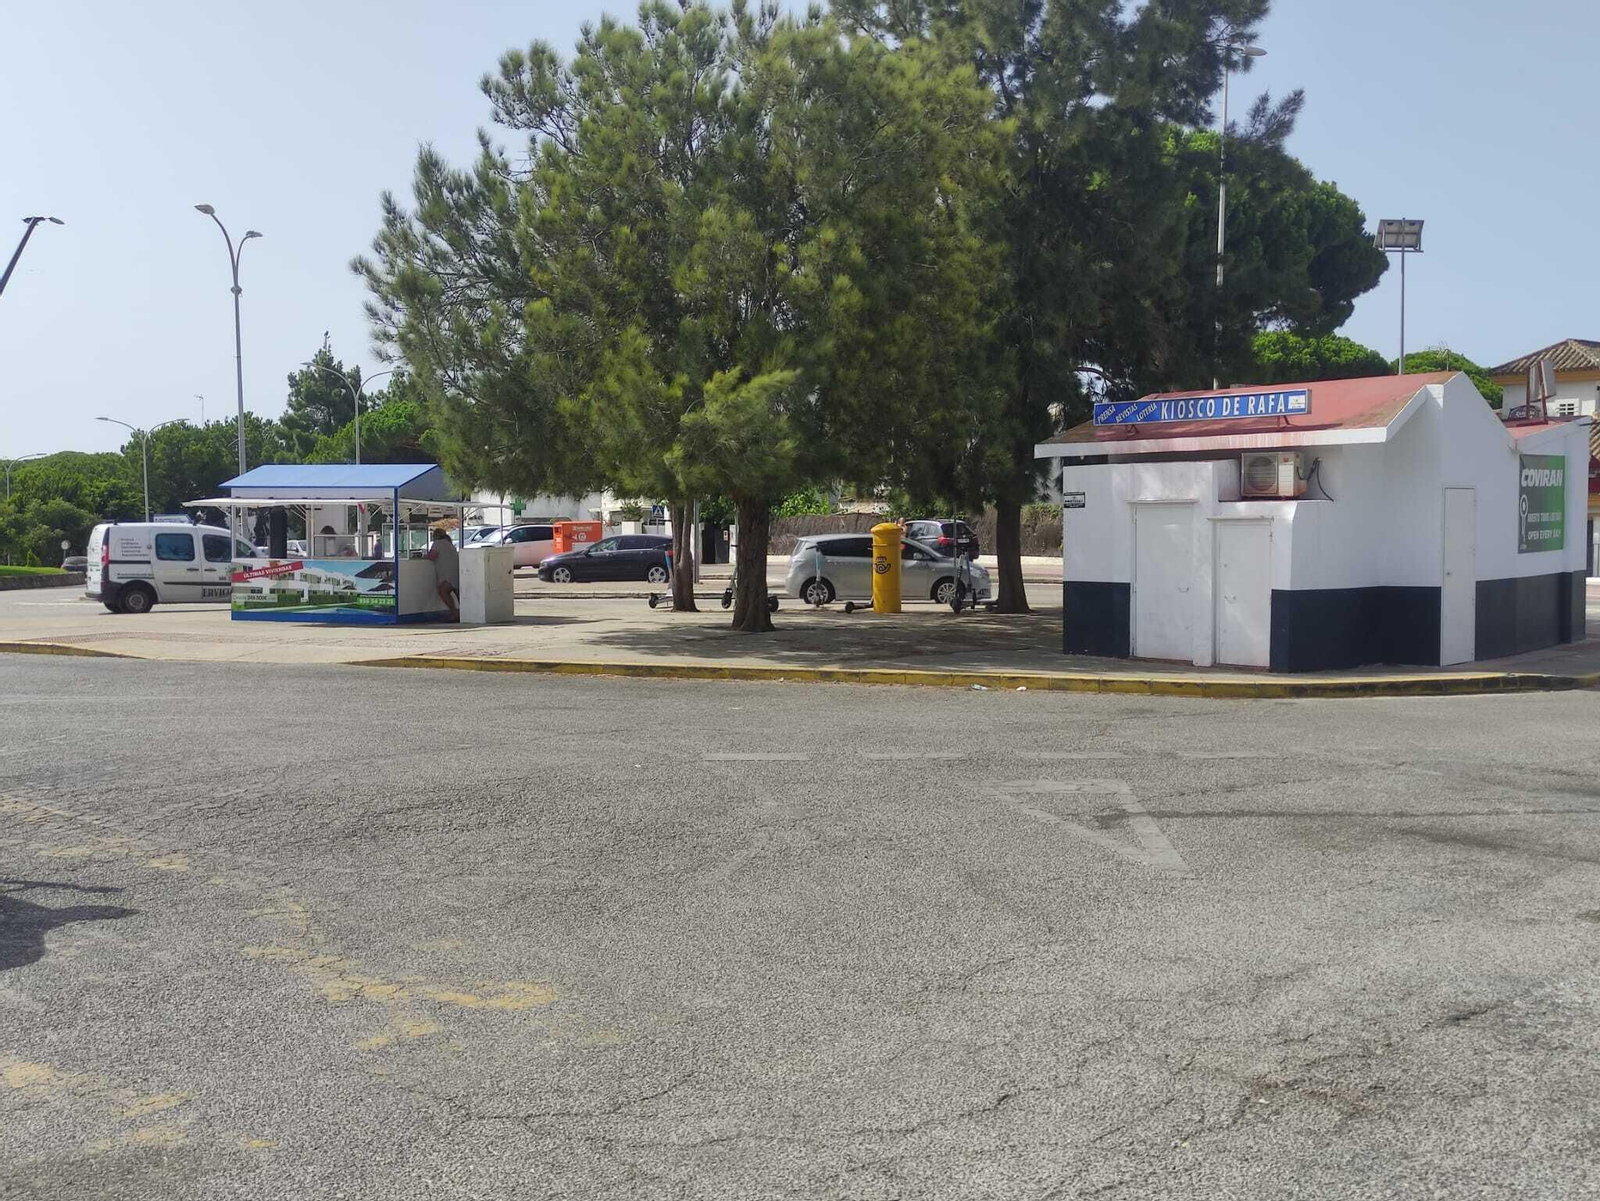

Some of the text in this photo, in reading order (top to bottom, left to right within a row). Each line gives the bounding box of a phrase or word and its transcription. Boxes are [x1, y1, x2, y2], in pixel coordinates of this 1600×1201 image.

[1115, 402, 1138, 423] REVISTAS
[1161, 399, 1215, 419] KIOSCO
[1222, 397, 1241, 416] DE
[1248, 393, 1285, 414] RAFA
[1521, 468, 1563, 487] COVIRAN
[1527, 530, 1539, 540] OPEN
[1540, 529, 1553, 539] EVERY
